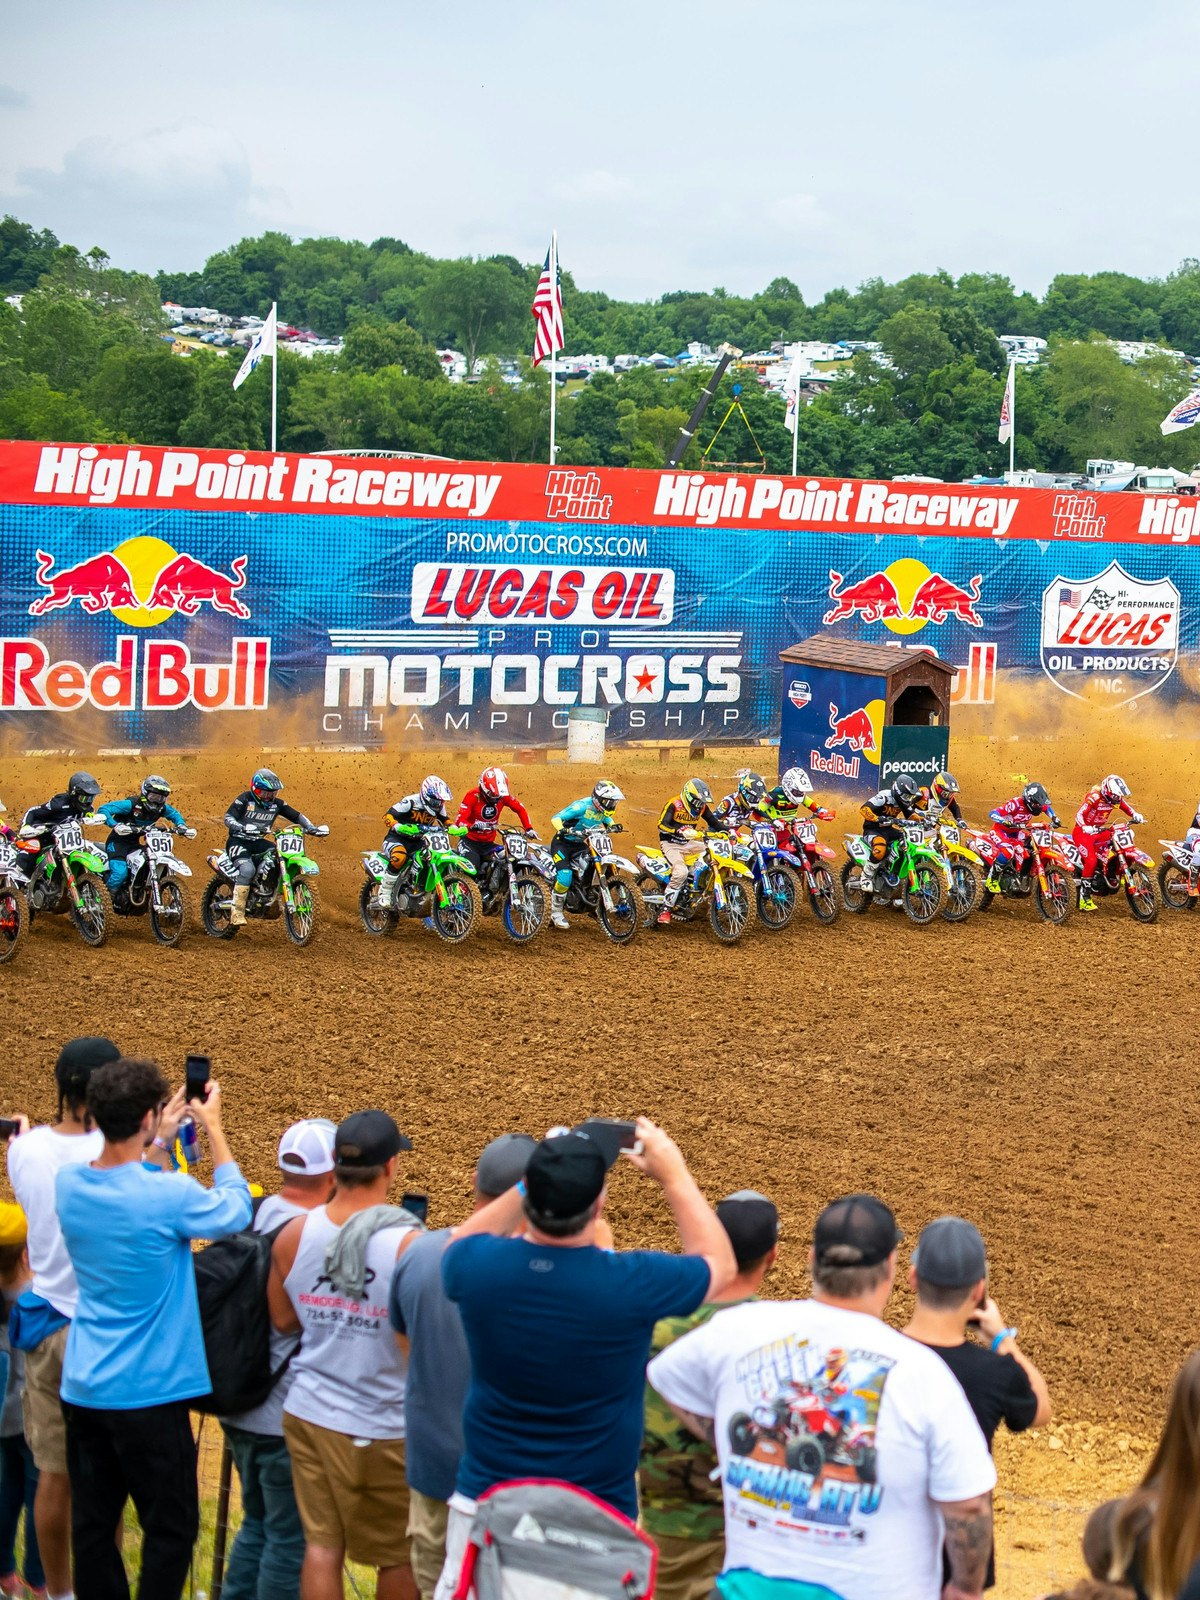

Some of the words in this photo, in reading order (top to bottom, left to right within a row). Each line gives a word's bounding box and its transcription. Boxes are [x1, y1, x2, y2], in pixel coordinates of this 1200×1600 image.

[34, 446, 151, 503] High
[155, 453, 290, 501] Point
[292, 458, 502, 516] Raceway
[546, 470, 600, 497] High
[548, 494, 612, 520] Point
[653, 474, 747, 524] High
[749, 480, 854, 522] Point
[855, 483, 1019, 535] Raceway
[1054, 494, 1097, 517] High
[1054, 512, 1106, 538] Point
[446, 532, 648, 557] PROMOTOCROSS.COM
[422, 567, 587, 620] LUCAS
[592, 569, 664, 620] OIL
[1117, 601, 1175, 609] PERFORMANCE
[1057, 611, 1172, 646] LUCAS
[488, 630, 600, 649] PRO
[1049, 656, 1077, 670] OIL
[1083, 656, 1170, 671] PRODUCTS
[1, 636, 137, 711] Red
[144, 637, 271, 712] Bull
[324, 654, 743, 708] MOTOCROSS
[1094, 678, 1126, 693] INC.
[323, 708, 740, 732] CHAMPIOSHIP
[811, 750, 834, 772] Red
[835, 753, 861, 779] Bull
[882, 756, 940, 780] peacock
[60, 831, 82, 849] 148
[758, 831, 775, 846] 715
[798, 824, 816, 839] 270
[908, 829, 924, 844] 57
[1035, 832, 1052, 845] 72
[1116, 831, 1134, 847] 51
[151, 838, 172, 853] 951
[281, 838, 303, 853] 647
[430, 835, 450, 851] 83
[508, 838, 528, 854] 637
[713, 842, 731, 855] 34
[851, 843, 865, 856] 57
[977, 841, 992, 853] 72
[1065, 845, 1080, 863] 51
[1176, 850, 1194, 867] 25
[368, 859, 384, 875] 83
[647, 859, 664, 872] 34
